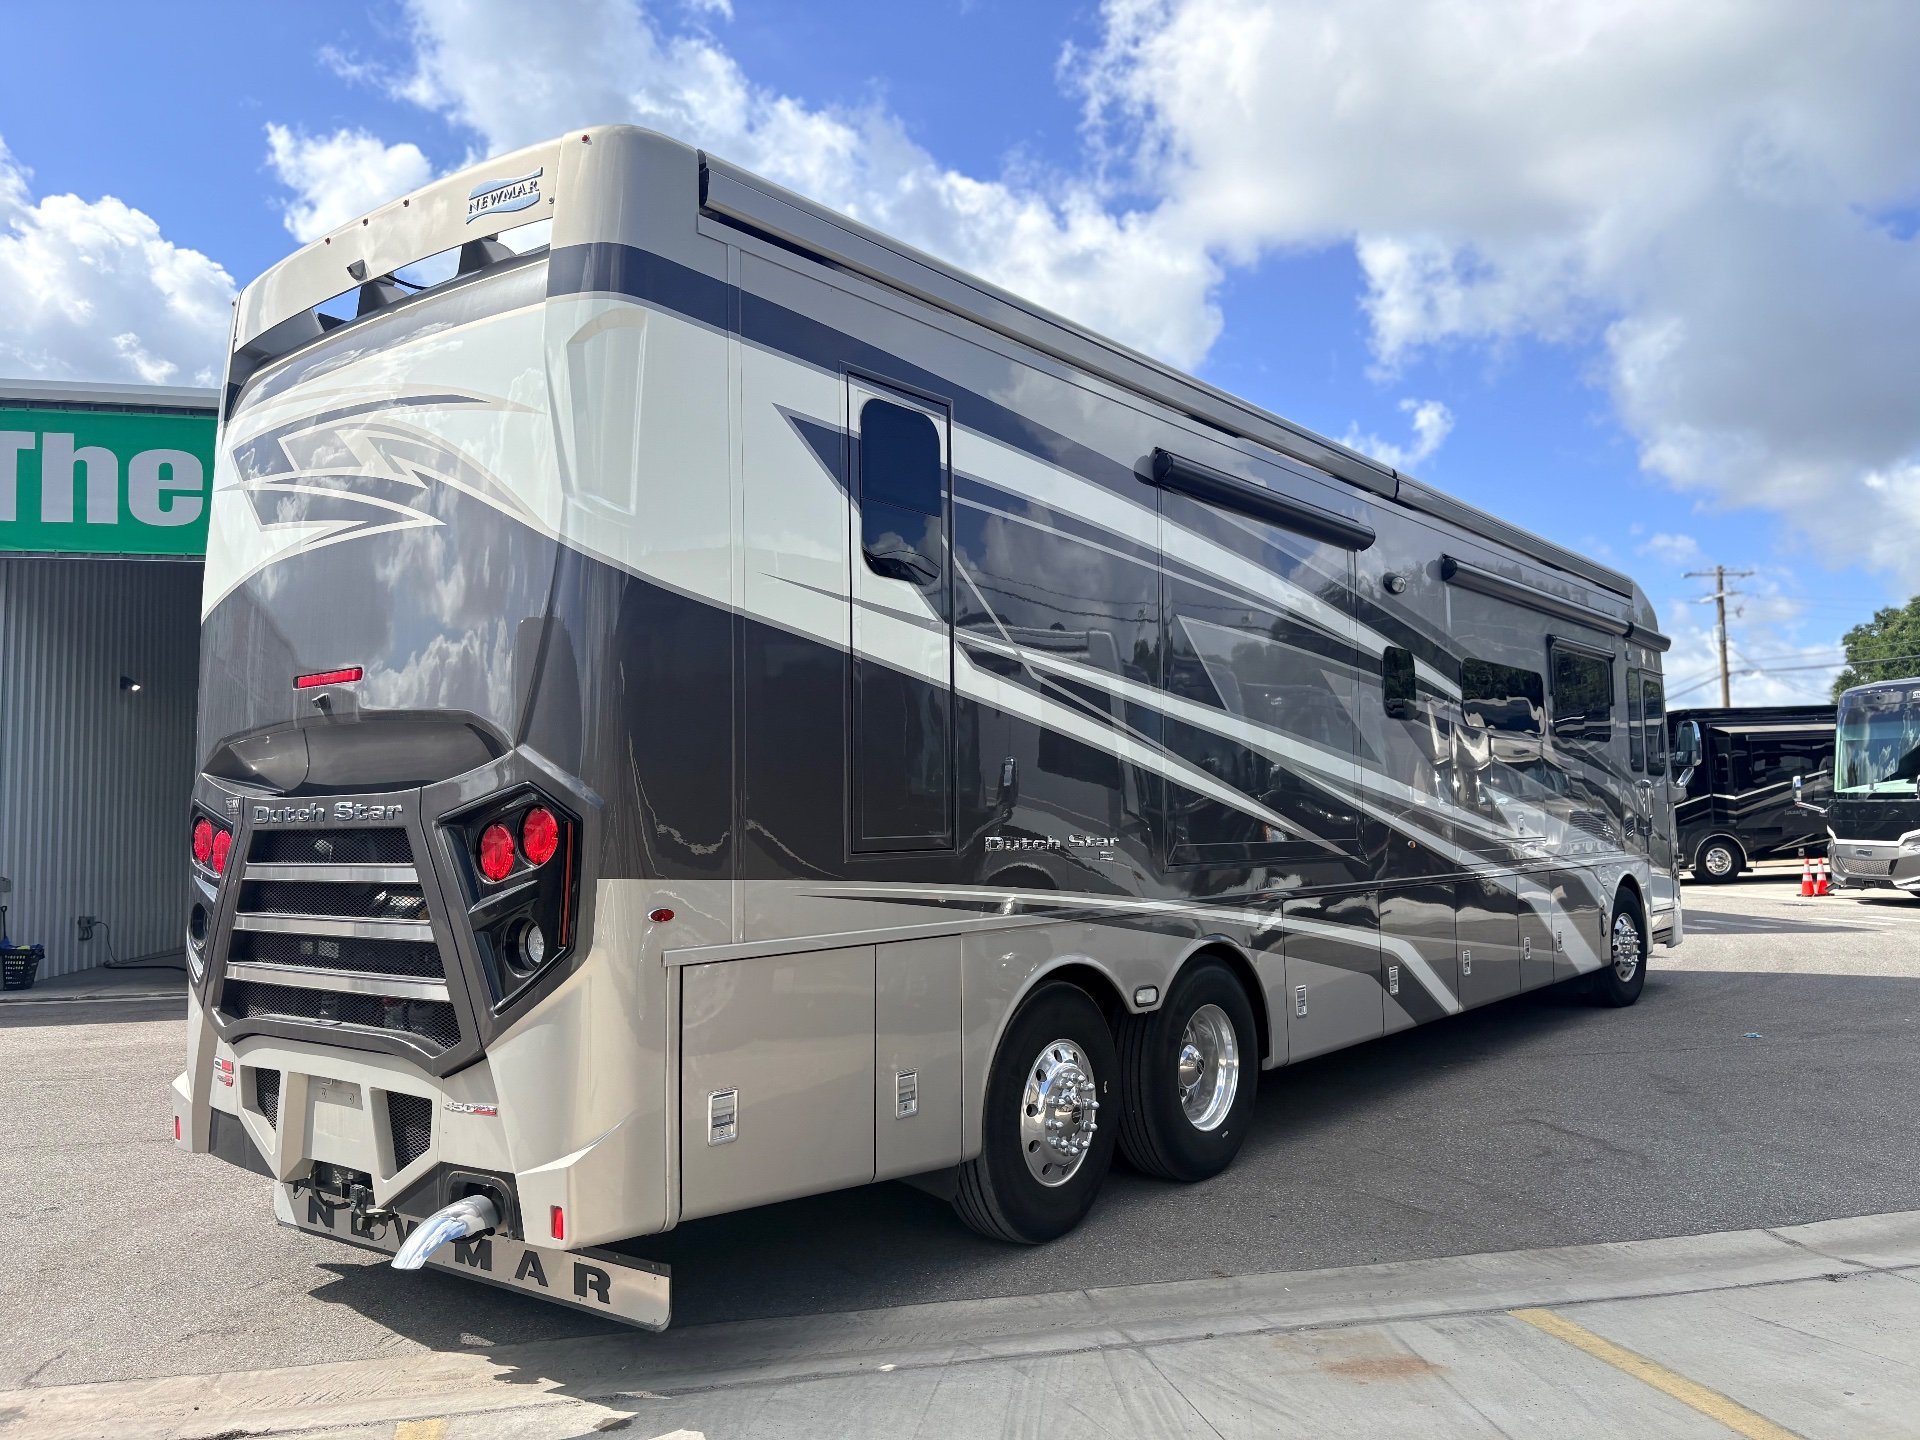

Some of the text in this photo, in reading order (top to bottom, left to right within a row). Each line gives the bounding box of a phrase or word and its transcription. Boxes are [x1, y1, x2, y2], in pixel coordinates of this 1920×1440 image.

[468, 180, 540, 214] NEWMAR
[253, 802, 325, 824] Dutch
[333, 801, 403, 821] Star
[984, 834, 1120, 852] Dutch Star
